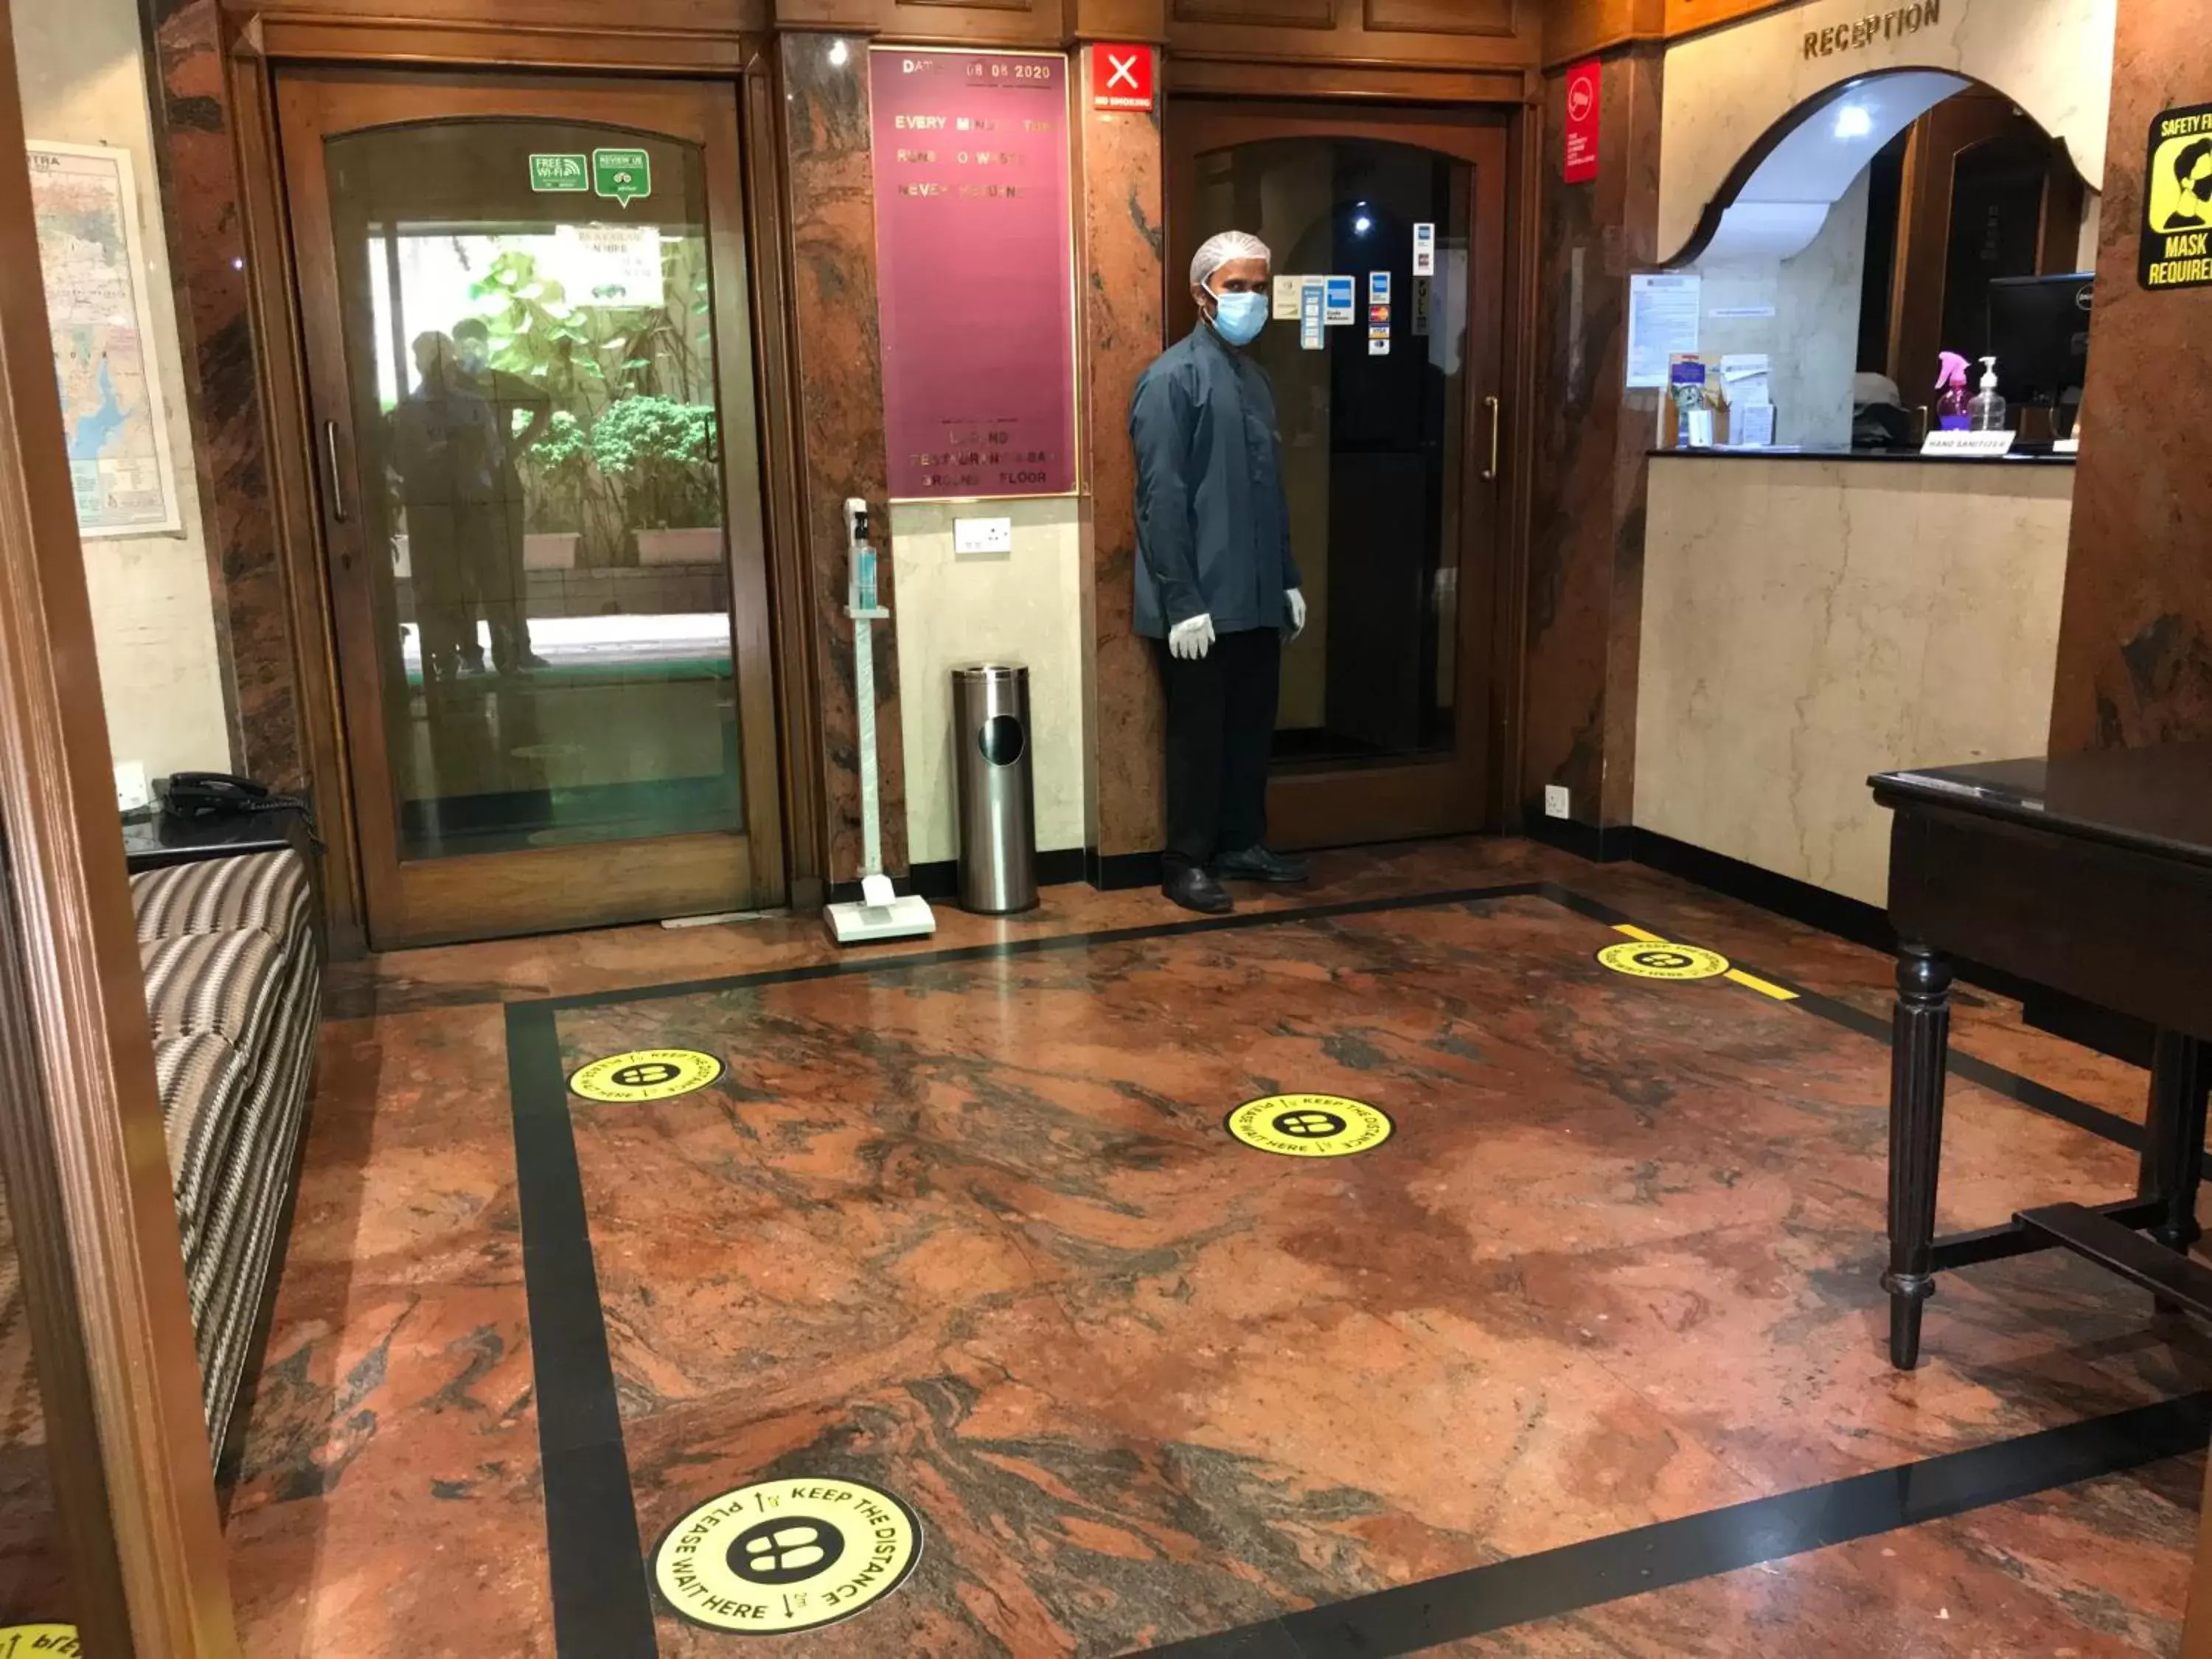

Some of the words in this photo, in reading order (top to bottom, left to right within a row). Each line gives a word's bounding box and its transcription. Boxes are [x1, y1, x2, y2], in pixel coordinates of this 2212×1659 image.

[1804, 0, 1940, 60] RECEPTION
[1015, 65, 1051, 78] 2020
[895, 115, 947, 130] EVERY
[2161, 115, 2199, 136] SAFETY
[536, 158, 562, 168] FREE
[2165, 233, 2208, 258] MASK
[2149, 258, 2212, 285] REQUIRE
[909, 451, 1005, 466] ESTAURAN
[1000, 470, 1046, 484] FLOOR
[1304, 1097, 1345, 1106] KEEP
[1269, 1140, 1308, 1152] HERE
[791, 1486, 853, 1503] KEEP
[853, 1498, 891, 1527] THE
[675, 1500, 745, 1554] PLEASE
[820, 1526, 897, 1607] DISTANCE
[672, 1556, 708, 1599] WAIT
[700, 1594, 768, 1620] HERE
